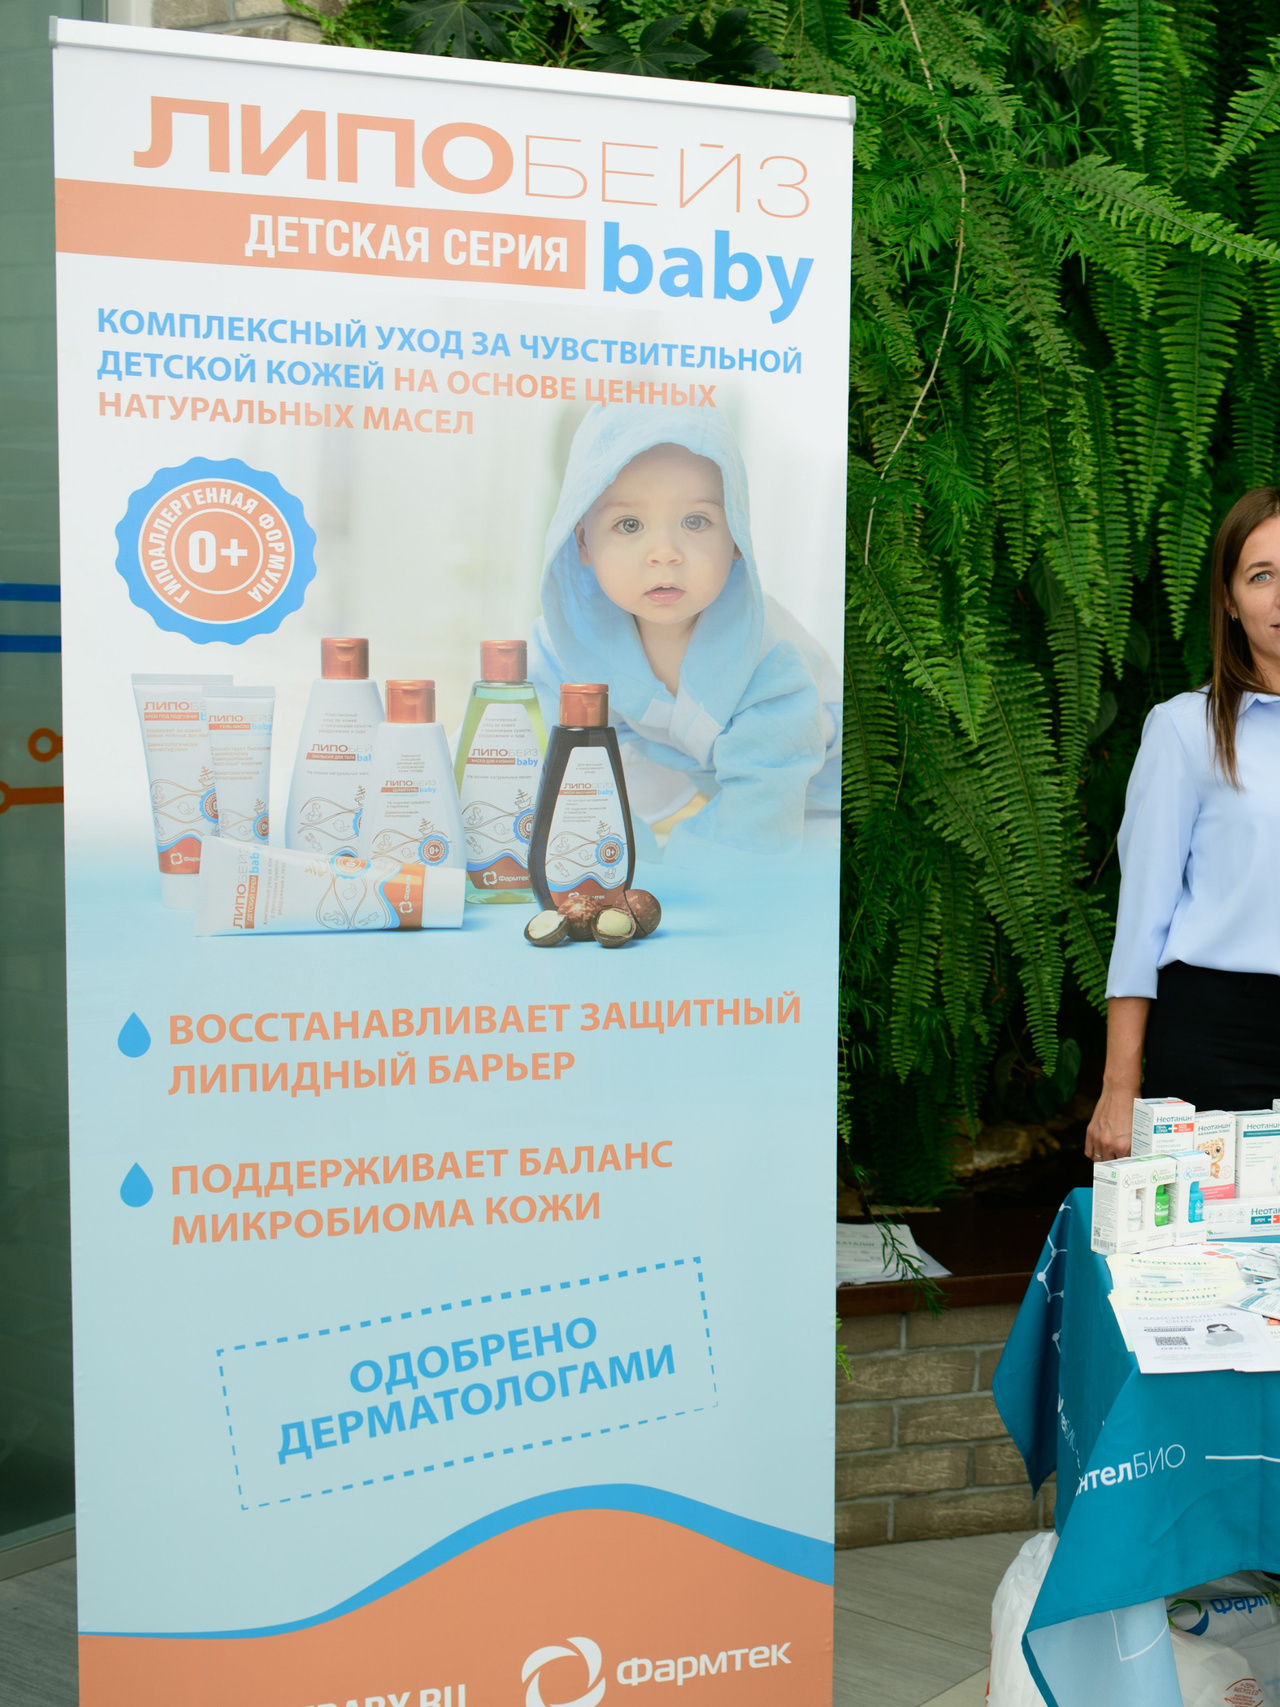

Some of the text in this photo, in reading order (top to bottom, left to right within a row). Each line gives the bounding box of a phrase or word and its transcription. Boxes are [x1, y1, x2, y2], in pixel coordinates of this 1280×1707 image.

[133, 95, 811, 219] ЛИПОБЕЙЗ
[244, 214, 568, 273] ДЕТСКАЯ СЕРИЯ
[601, 221, 815, 325] baby
[97, 307, 802, 374] КОМПЛЕКСНЫЙ УХОД ЗА ЧУВСТВИТЕЛЬНОЙ
[97, 349, 717, 410] ДЕТСКОЙ КОЖЕЙ НА ОСНОВЕ ЦЕННЫХ
[97, 391, 474, 436] НАТУРАЛЬНЫХ МАСЕЛ
[148, 487, 286, 604] ГИПОАЛЛЕРГЕННАЯ ФОРМУЛА
[188, 530, 248, 573] 0+
[517, 757, 538, 768] baby
[168, 992, 802, 1045] ВОССТАНАВЛИВАЕТ ЗАЩИТНЫЙ
[168, 1051, 576, 1097] ЛИПИДНЫЙ БАРЬЕР
[170, 1140, 674, 1199] ПОДДЕРЖИВАЕТ БАЛАНС
[171, 1192, 602, 1246] МИКРОБИОМА КОЖИ
[349, 1315, 599, 1398] ОДОБРЕНО
[276, 1344, 677, 1466] ДЕРМАТОЛОГАМИ
[616, 1642, 792, 1686] Фармтек
